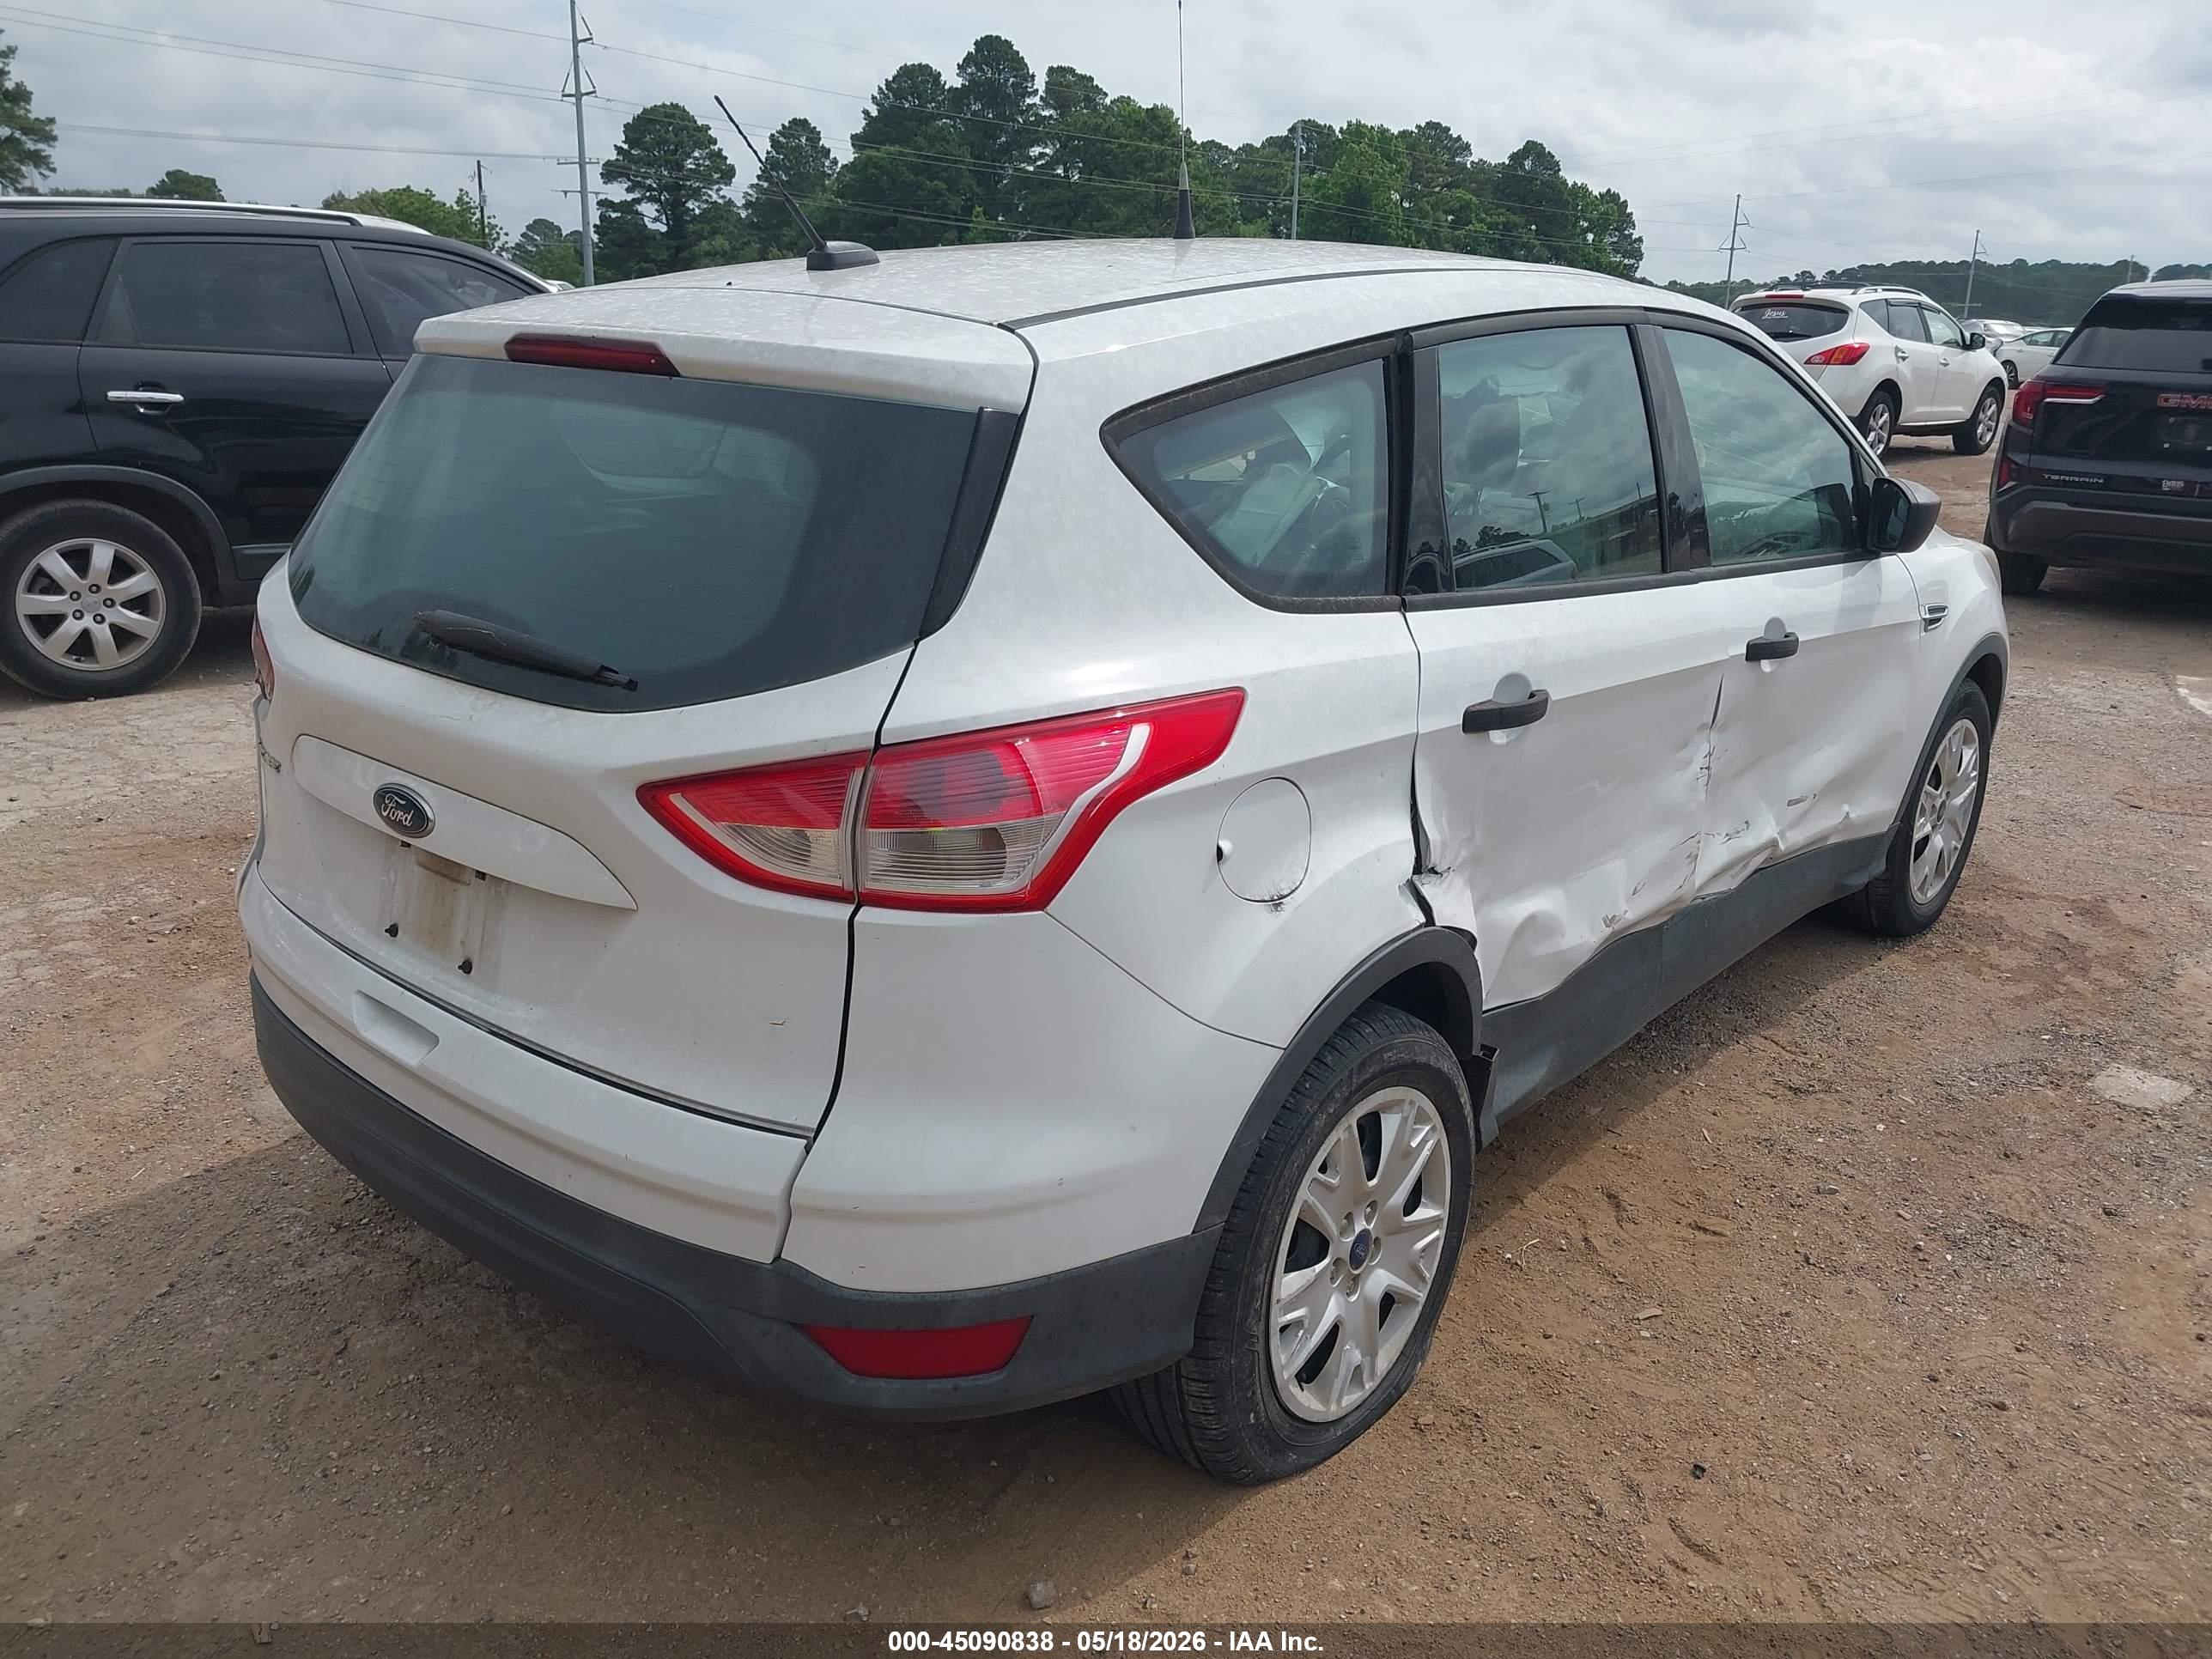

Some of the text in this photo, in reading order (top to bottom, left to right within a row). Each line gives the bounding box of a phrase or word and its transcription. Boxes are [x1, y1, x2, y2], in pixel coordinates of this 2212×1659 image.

[1763, 308, 1788, 319] Jesus
[2157, 393, 2212, 410] GM
[2042, 473, 2104, 483] TERRAIN
[381, 793, 414, 827] Ford
